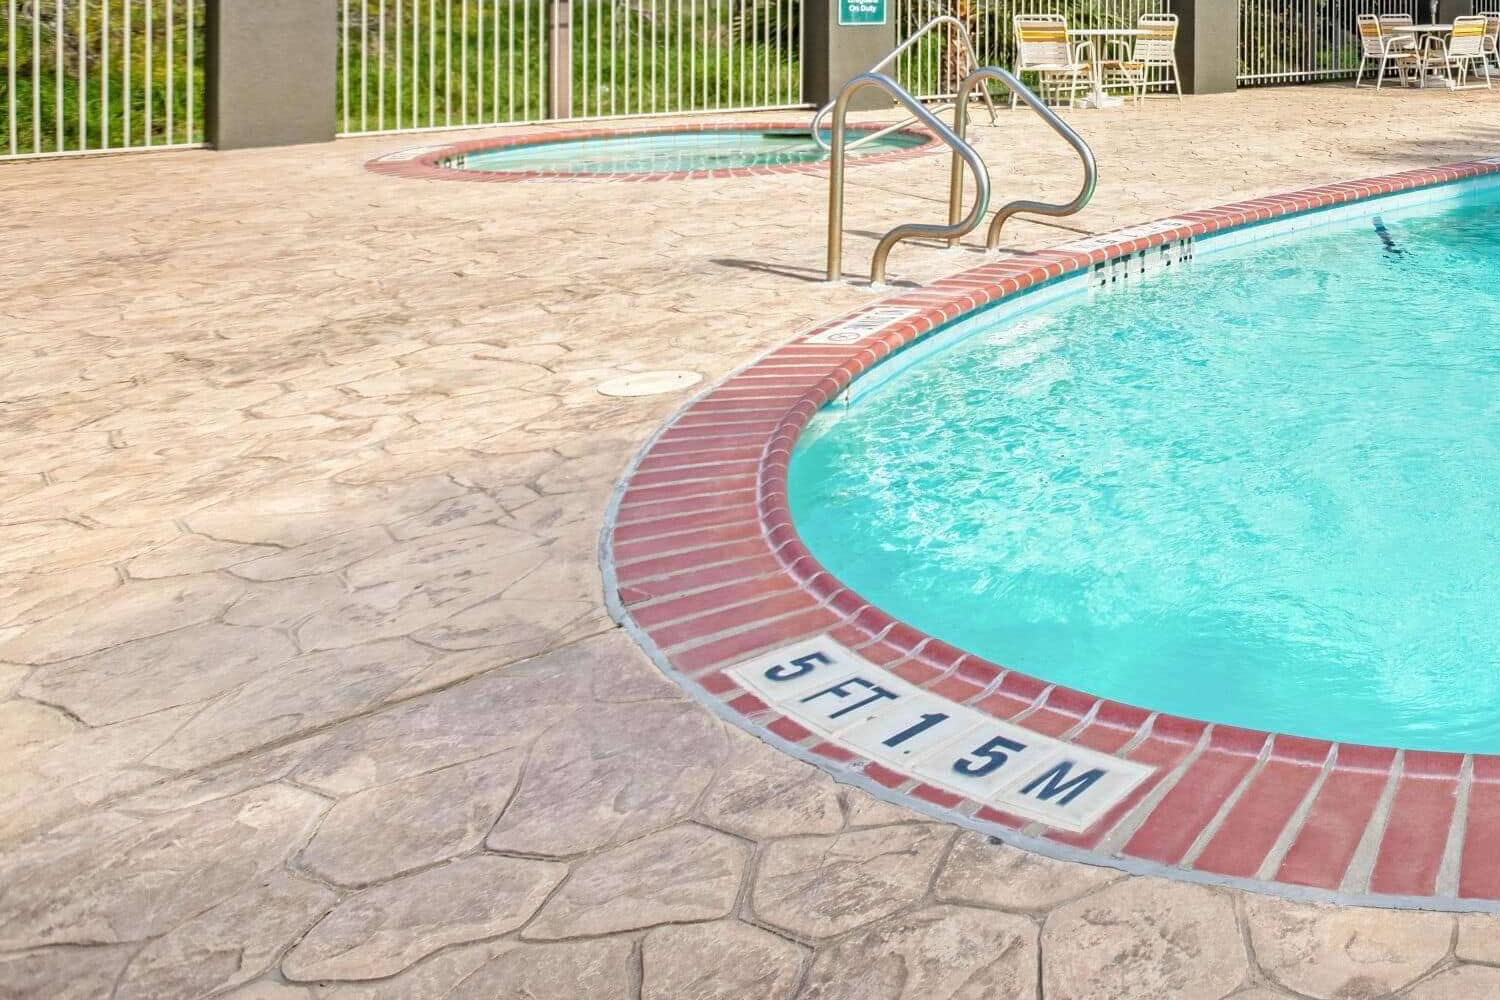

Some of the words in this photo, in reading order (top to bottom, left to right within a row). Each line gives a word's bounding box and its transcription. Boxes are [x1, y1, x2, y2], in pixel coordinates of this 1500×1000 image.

[860, 5, 877, 13] Duty
[764, 651, 837, 683] 5
[800, 676, 901, 719] FT
[952, 735, 1028, 778] 5
[1018, 759, 1109, 806] M
